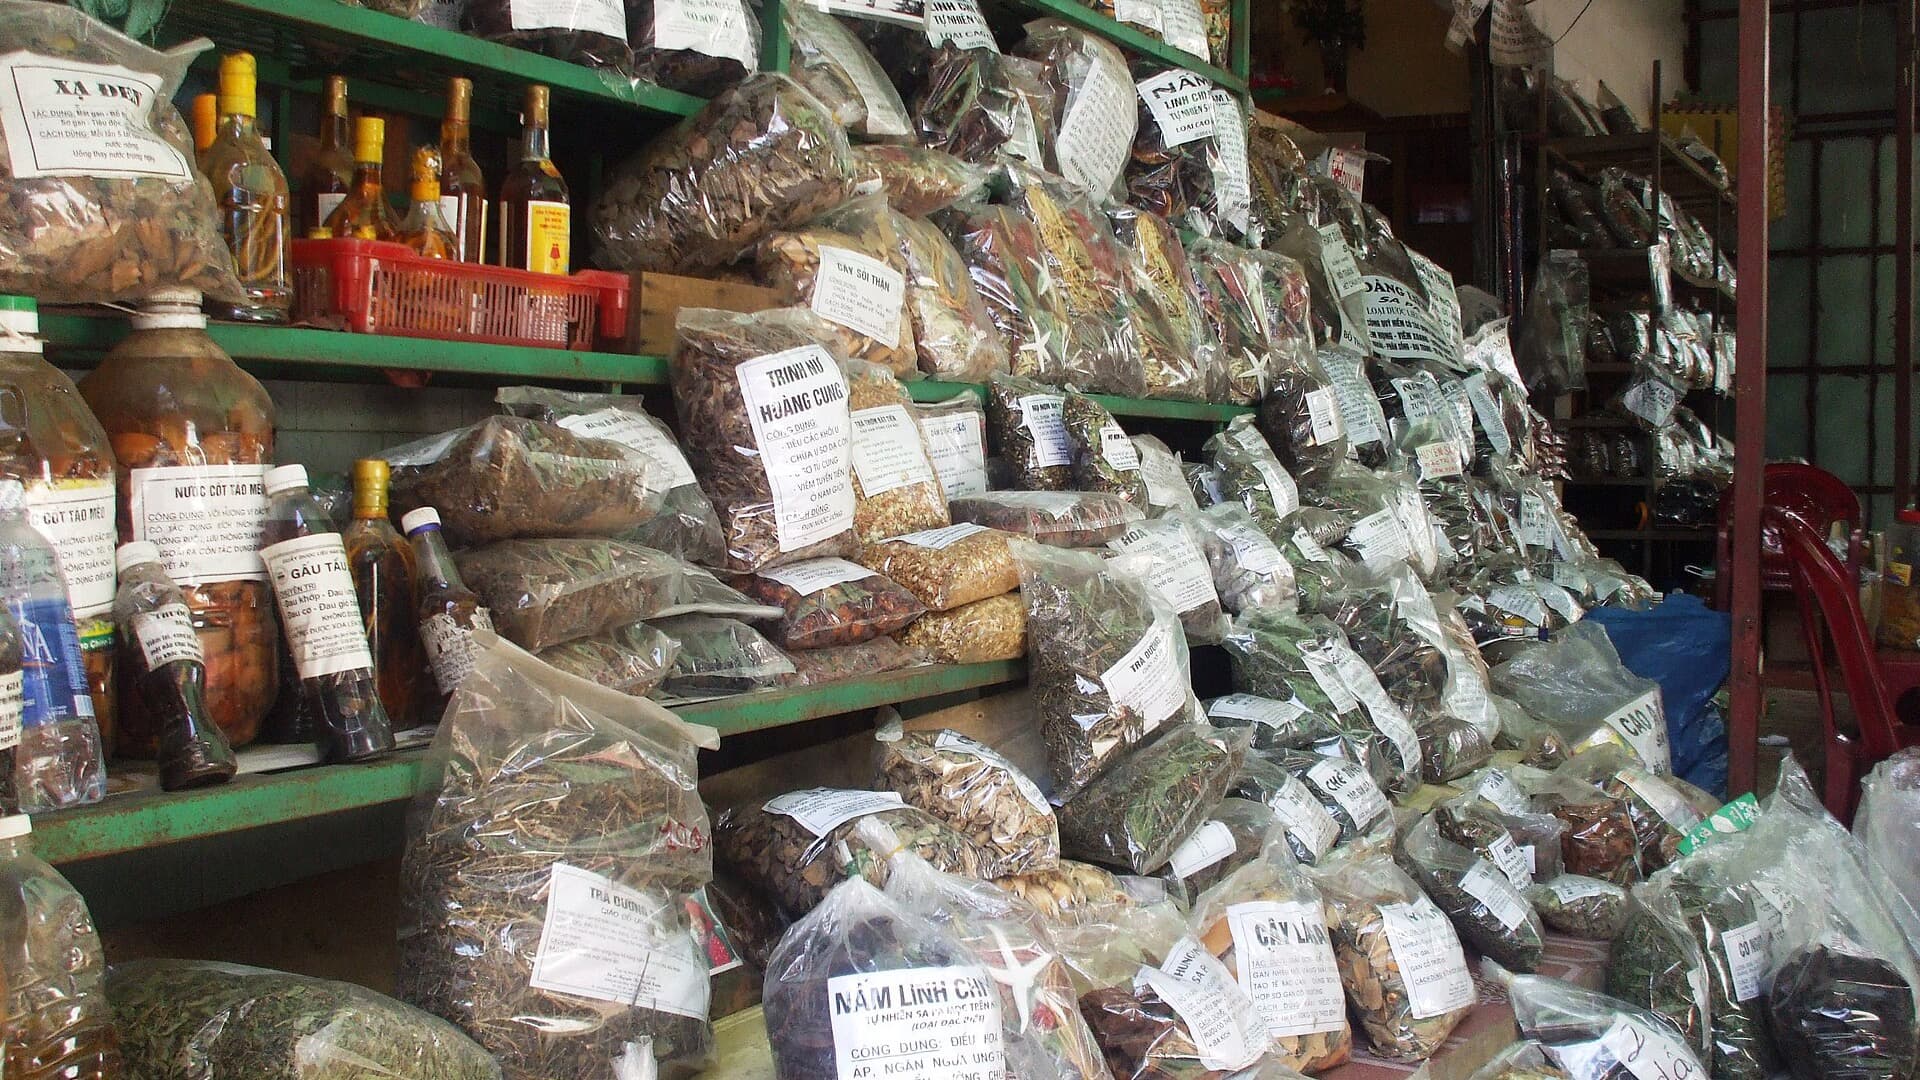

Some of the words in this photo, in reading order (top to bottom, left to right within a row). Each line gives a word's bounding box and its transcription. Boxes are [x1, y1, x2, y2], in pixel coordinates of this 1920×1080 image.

[54, 79, 91, 101] XẠ
[1378, 296, 1401, 304] SA
[760, 391, 812, 424] HOÀNG
[815, 381, 844, 408] CUNG
[803, 431, 819, 444] CÁC
[821, 456, 839, 470] CUNG
[210, 482, 227, 498] CỐT
[43, 507, 66, 525] CỐT
[148, 512, 177, 521] CÔNG
[318, 602, 337, 611] Đau
[1618, 709, 1652, 737] CAO
[1254, 918, 1290, 947] CÂY
[835, 978, 892, 1016] NẤM
[899, 980, 948, 1008] LINH
[916, 1008, 930, 1019] SA
[850, 1043, 892, 1060] CÔNG
[1620, 1024, 1645, 1063] 2
[972, 1051, 995, 1065] UNG
